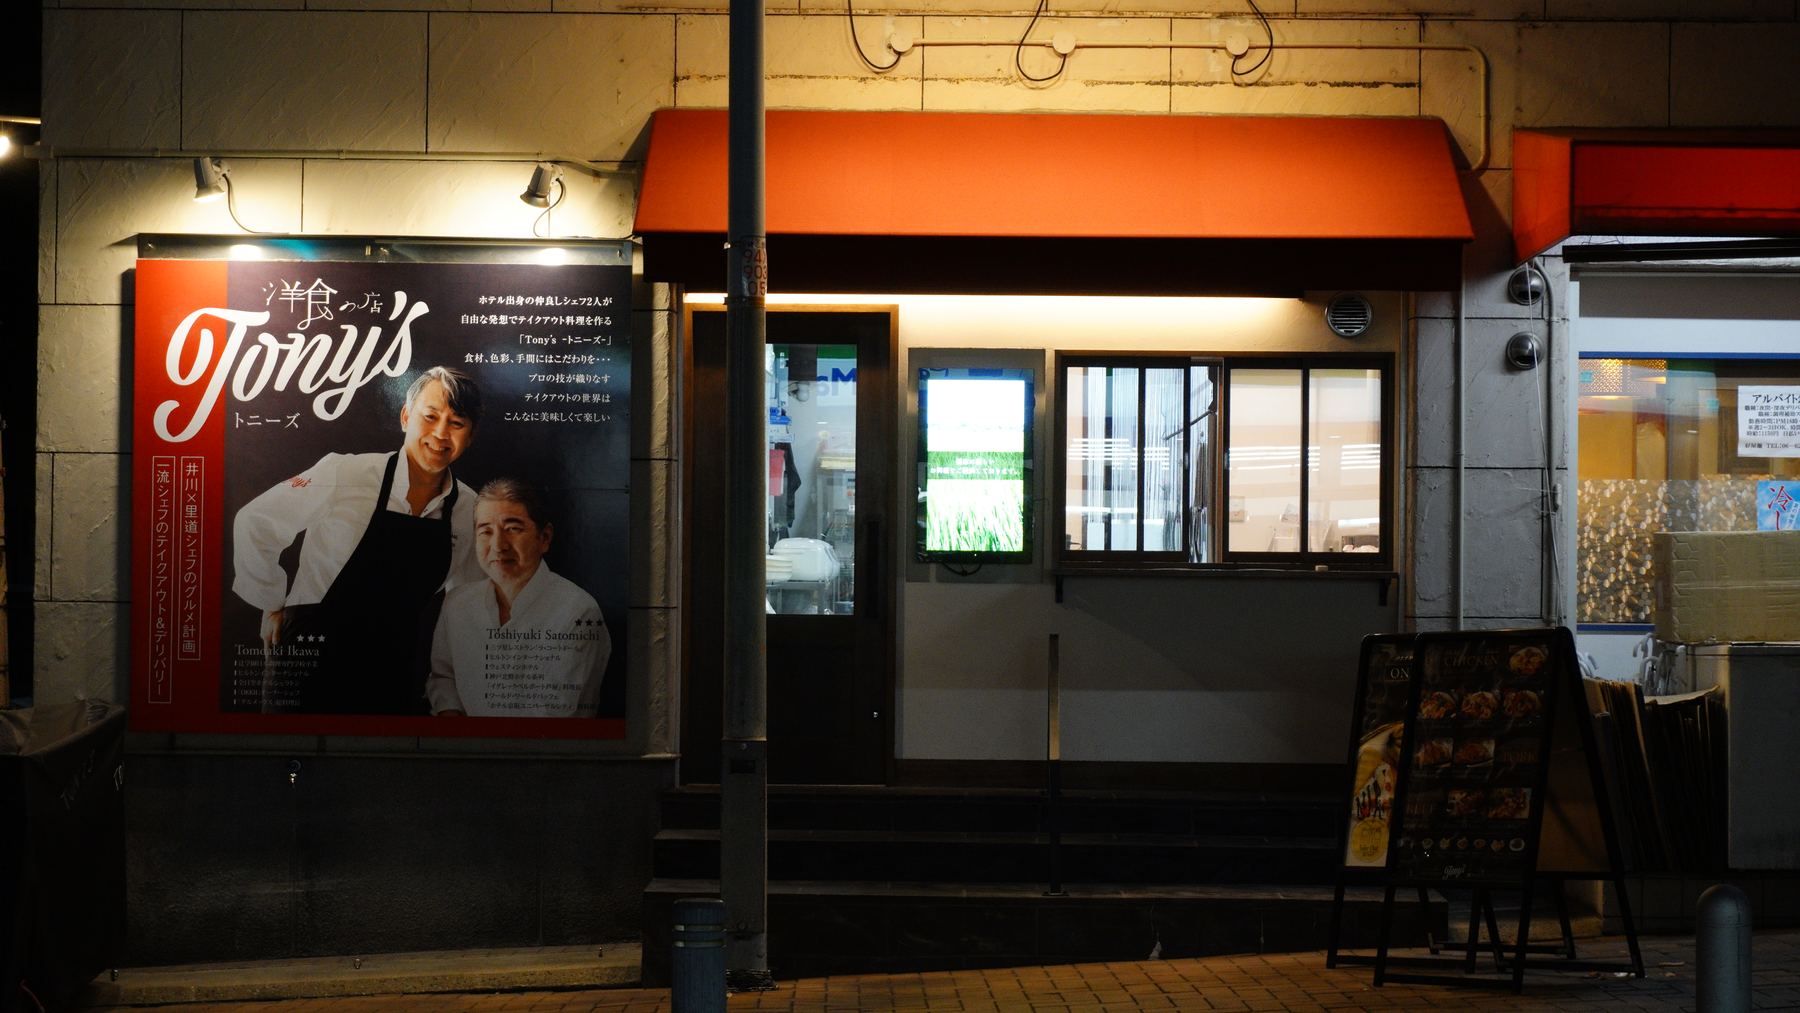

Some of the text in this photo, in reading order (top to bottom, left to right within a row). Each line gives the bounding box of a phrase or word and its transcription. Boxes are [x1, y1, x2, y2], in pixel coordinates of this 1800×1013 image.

[479, 295, 613, 307] ホテル出身の仲良しシェフ2人が
[461, 314, 612, 326] 自由な発想でテイクアウト料理を作る
[153, 290, 430, 443] Tony's
[528, 373, 611, 384] プロの技が織りなす
[524, 393, 611, 403] テイクアウトの世界は
[235, 412, 301, 430] トニーズ
[504, 411, 611, 423] こんなに美味しくて楽しい
[182, 462, 199, 653] 井川×里道シェフのグルメ計画
[153, 463, 170, 696] 一流シェフのテイクアウト&デリバリー
[486, 628, 600, 642] Toshiyuki Satomichi
[288, 644, 320, 656] Ikawa
